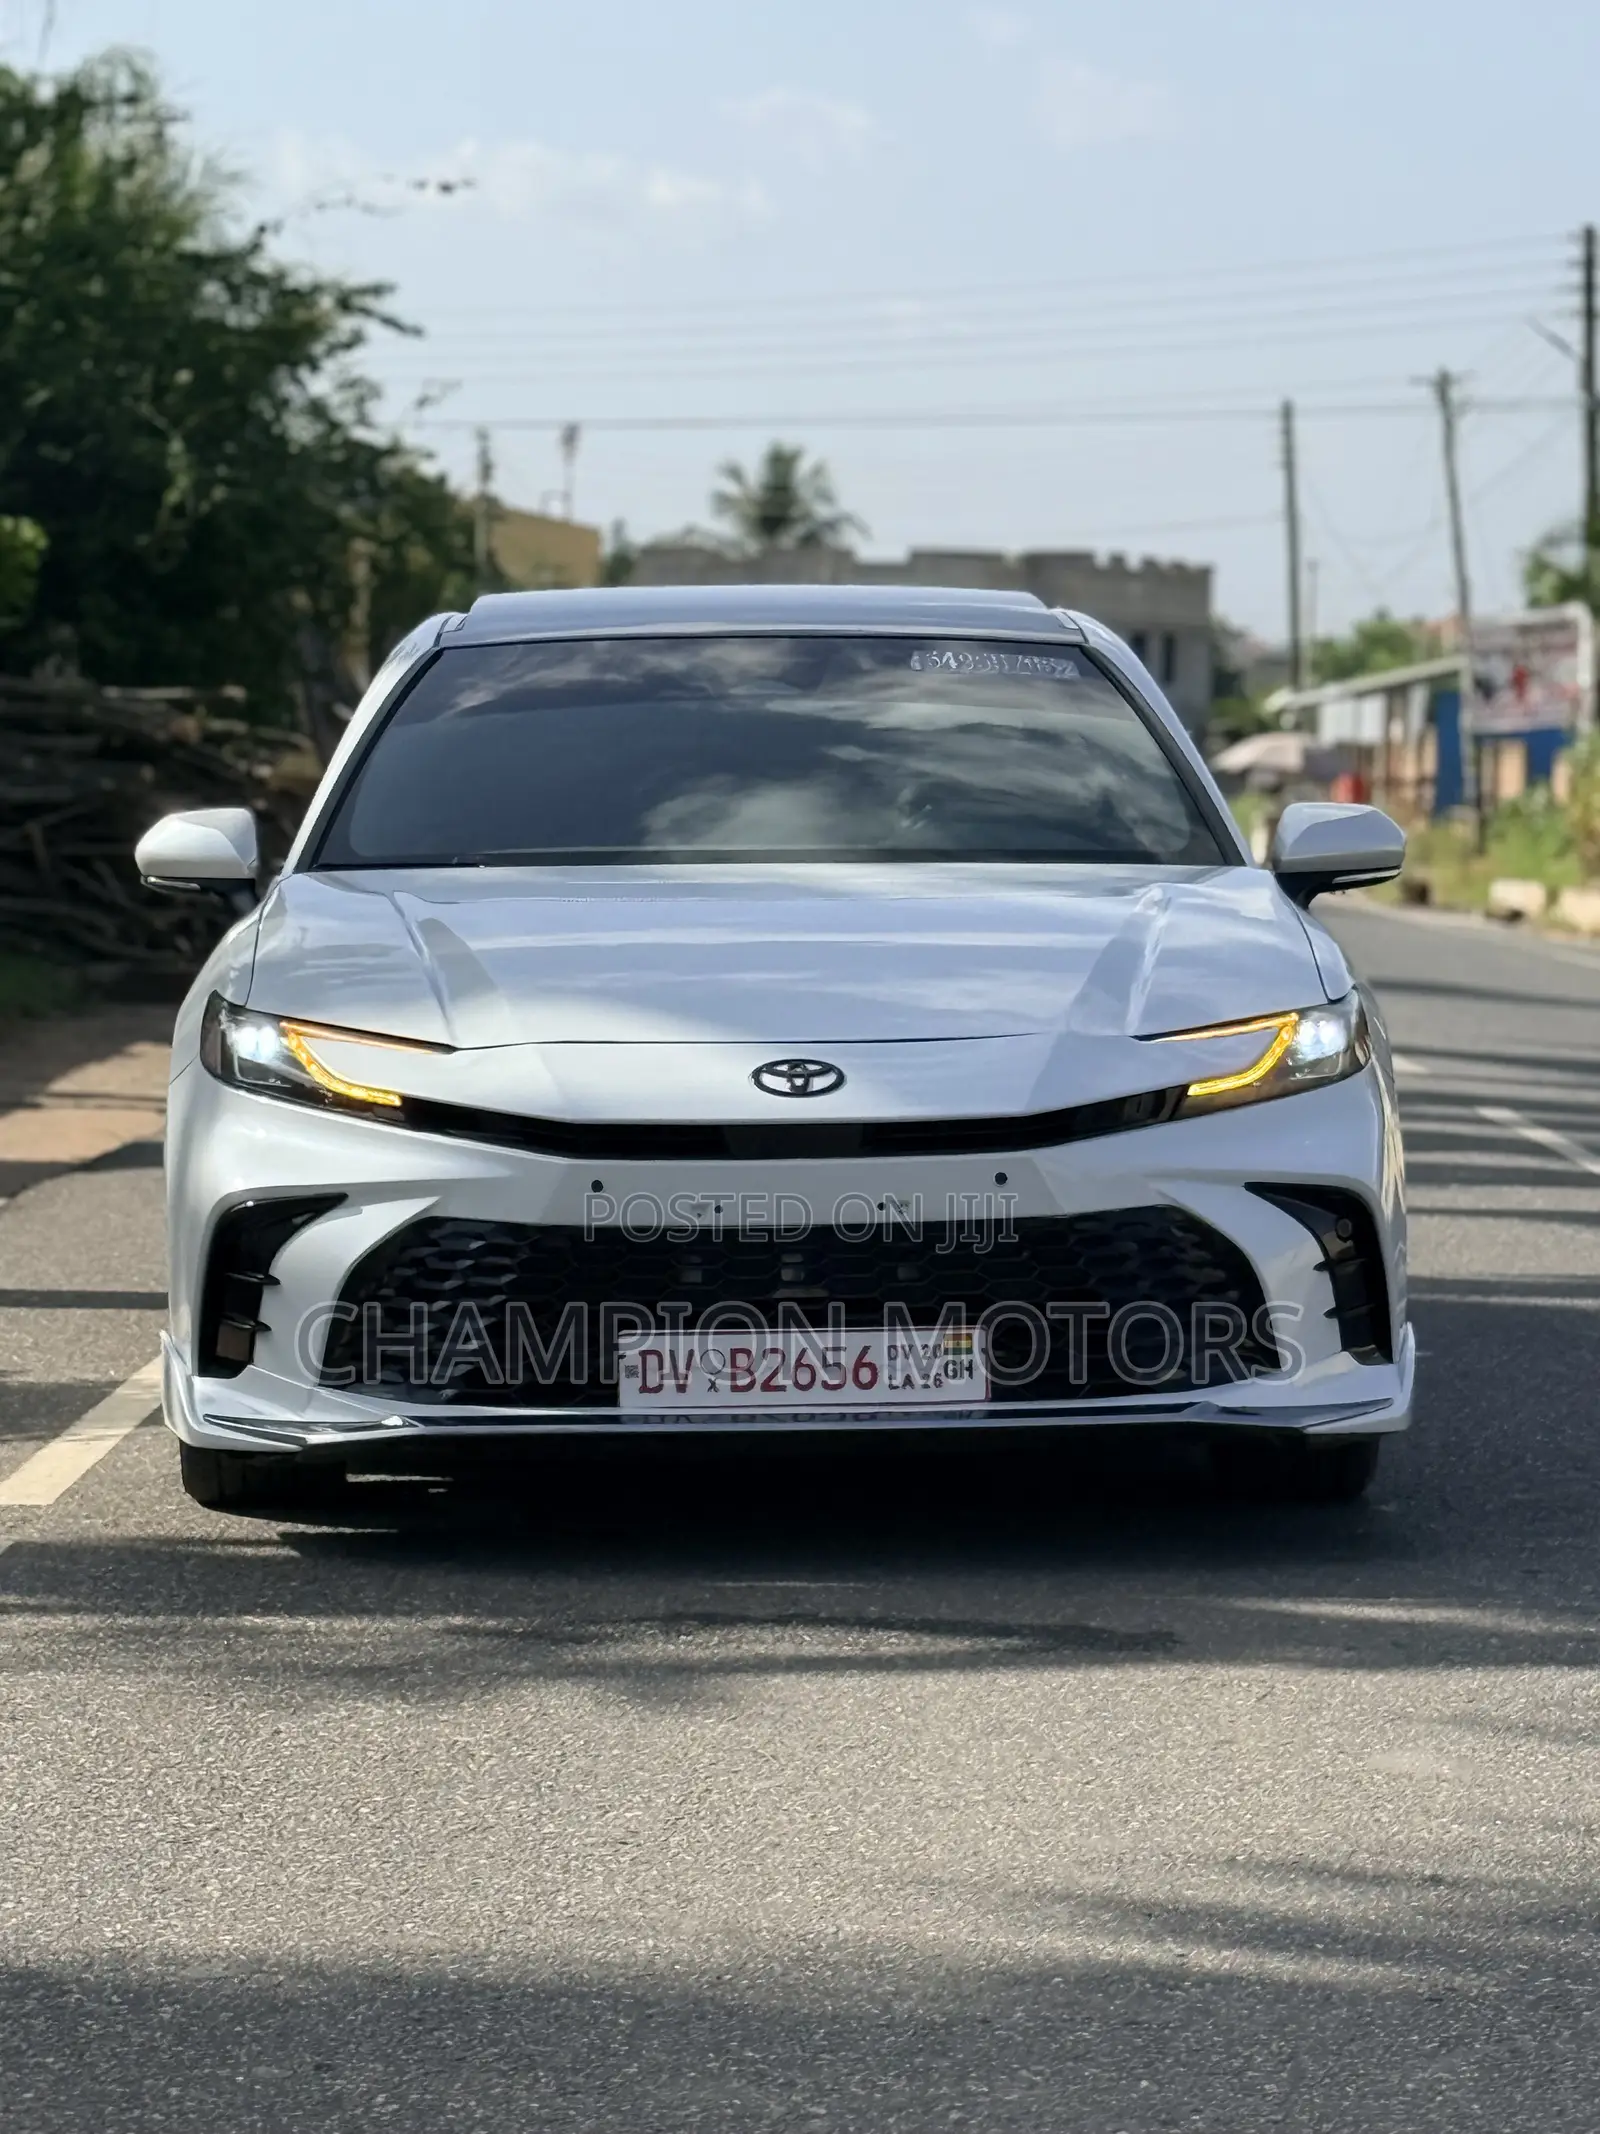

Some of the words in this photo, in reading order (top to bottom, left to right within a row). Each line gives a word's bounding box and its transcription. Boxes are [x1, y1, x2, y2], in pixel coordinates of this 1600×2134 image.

[638, 1348, 695, 1394] DV
[729, 1345, 878, 1393] B2656
[943, 1359, 974, 1380] GH
